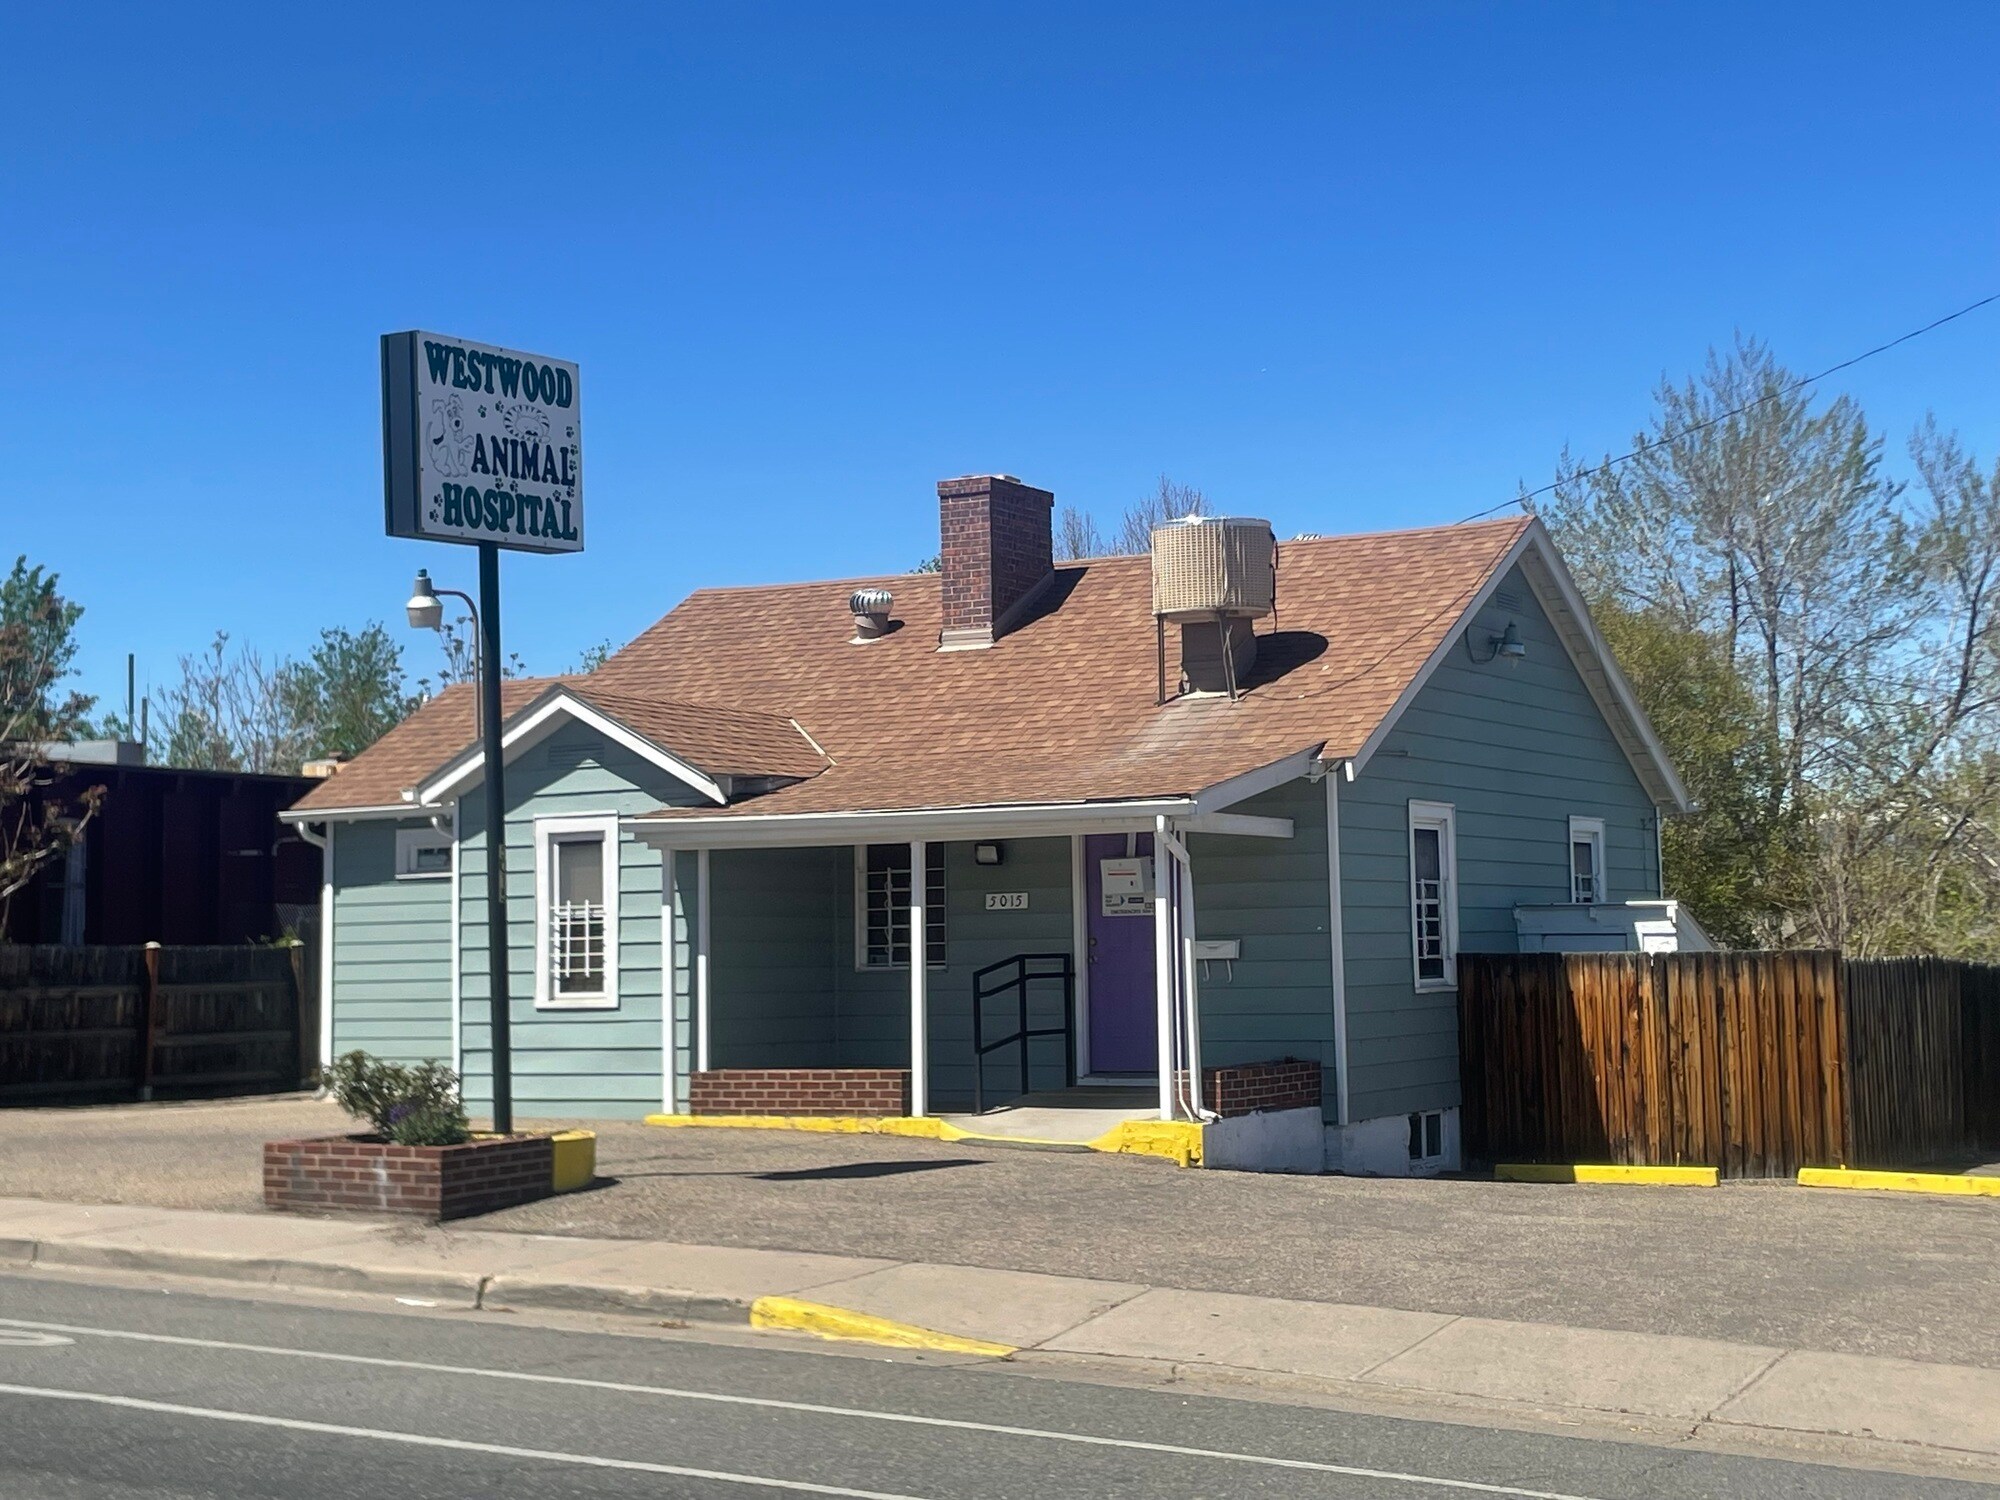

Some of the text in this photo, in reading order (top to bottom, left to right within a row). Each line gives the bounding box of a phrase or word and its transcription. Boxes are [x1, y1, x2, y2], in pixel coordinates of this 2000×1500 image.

[424, 341, 572, 408] WESTWOOD
[471, 433, 576, 487] ANIMAL
[442, 482, 578, 541] HOSPITAL
[989, 895, 1022, 907] 5015
